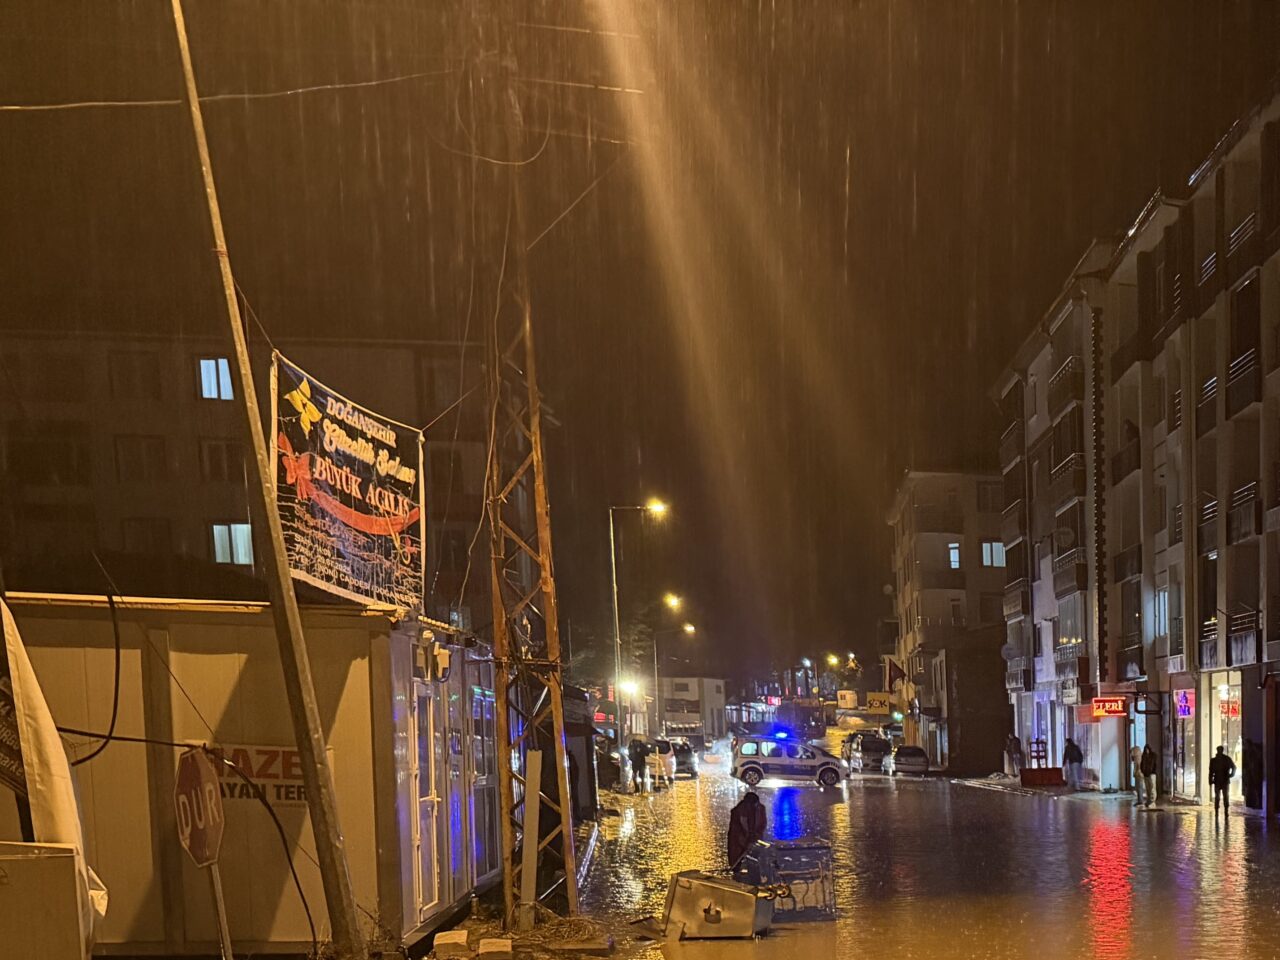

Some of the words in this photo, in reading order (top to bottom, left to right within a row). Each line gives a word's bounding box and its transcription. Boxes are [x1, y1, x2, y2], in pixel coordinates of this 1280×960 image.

[326, 396, 396, 449] DOĞANŞEHİR
[314, 455, 362, 500] BÜYÜK
[213, 748, 303, 780] AZE
[179, 783, 221, 835] DUR
